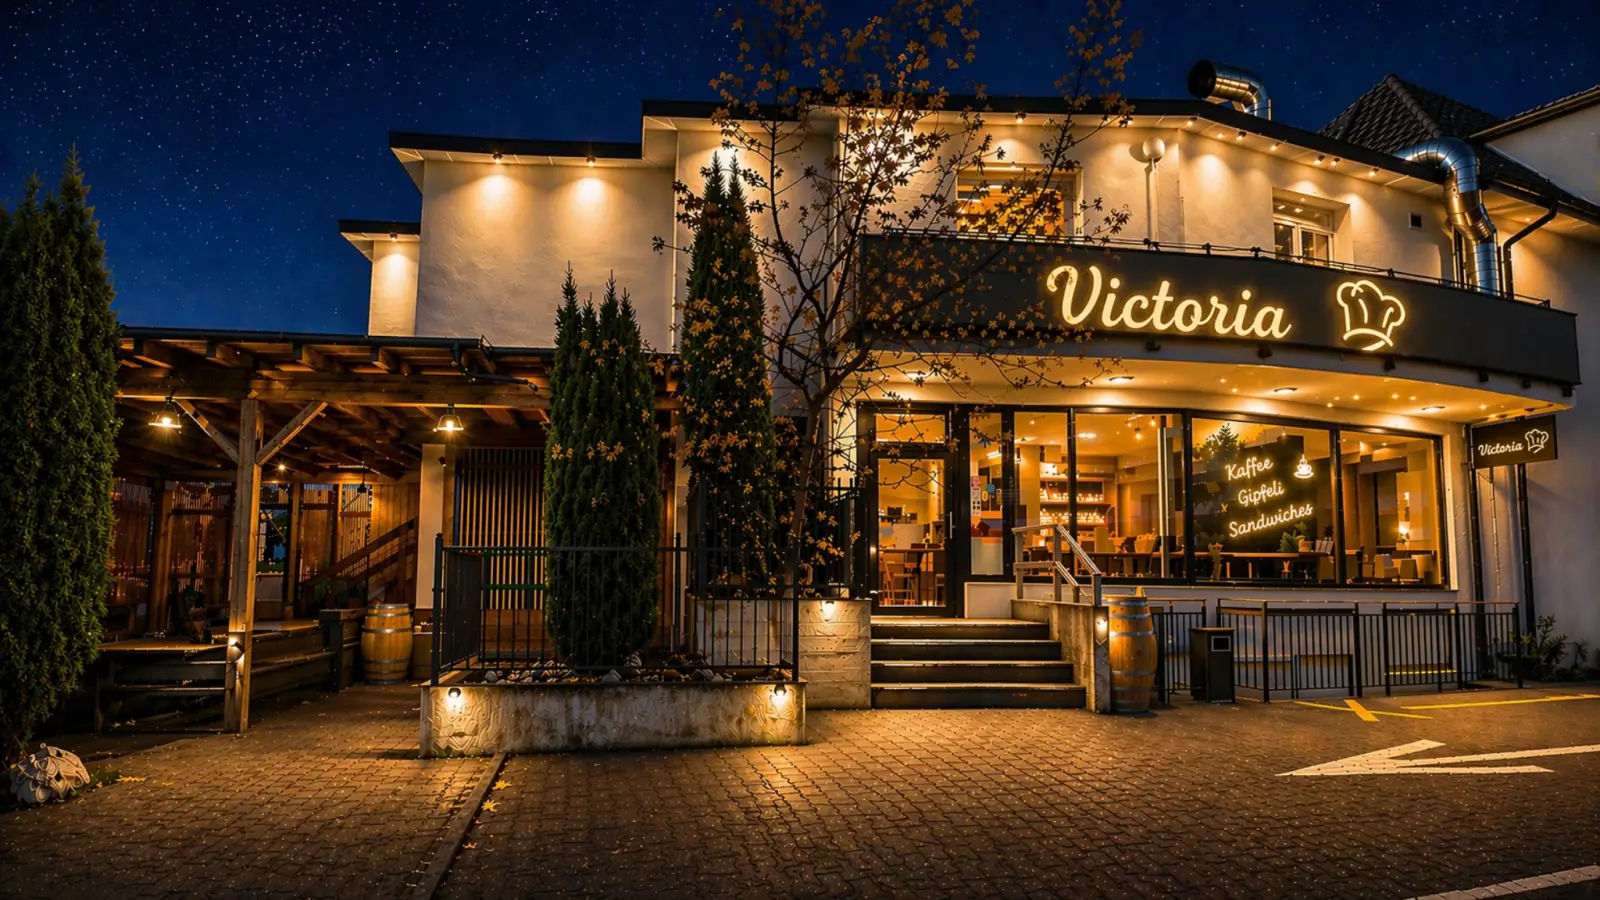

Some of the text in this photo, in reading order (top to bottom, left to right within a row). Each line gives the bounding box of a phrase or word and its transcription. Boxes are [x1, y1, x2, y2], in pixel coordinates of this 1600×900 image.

[1046, 265, 1292, 339] Victoria
[1478, 441, 1524, 456] Victoria
[1225, 456, 1273, 481] Kaffee
[1238, 480, 1284, 507] Gipfeli
[1229, 504, 1313, 538] Sandwiches
